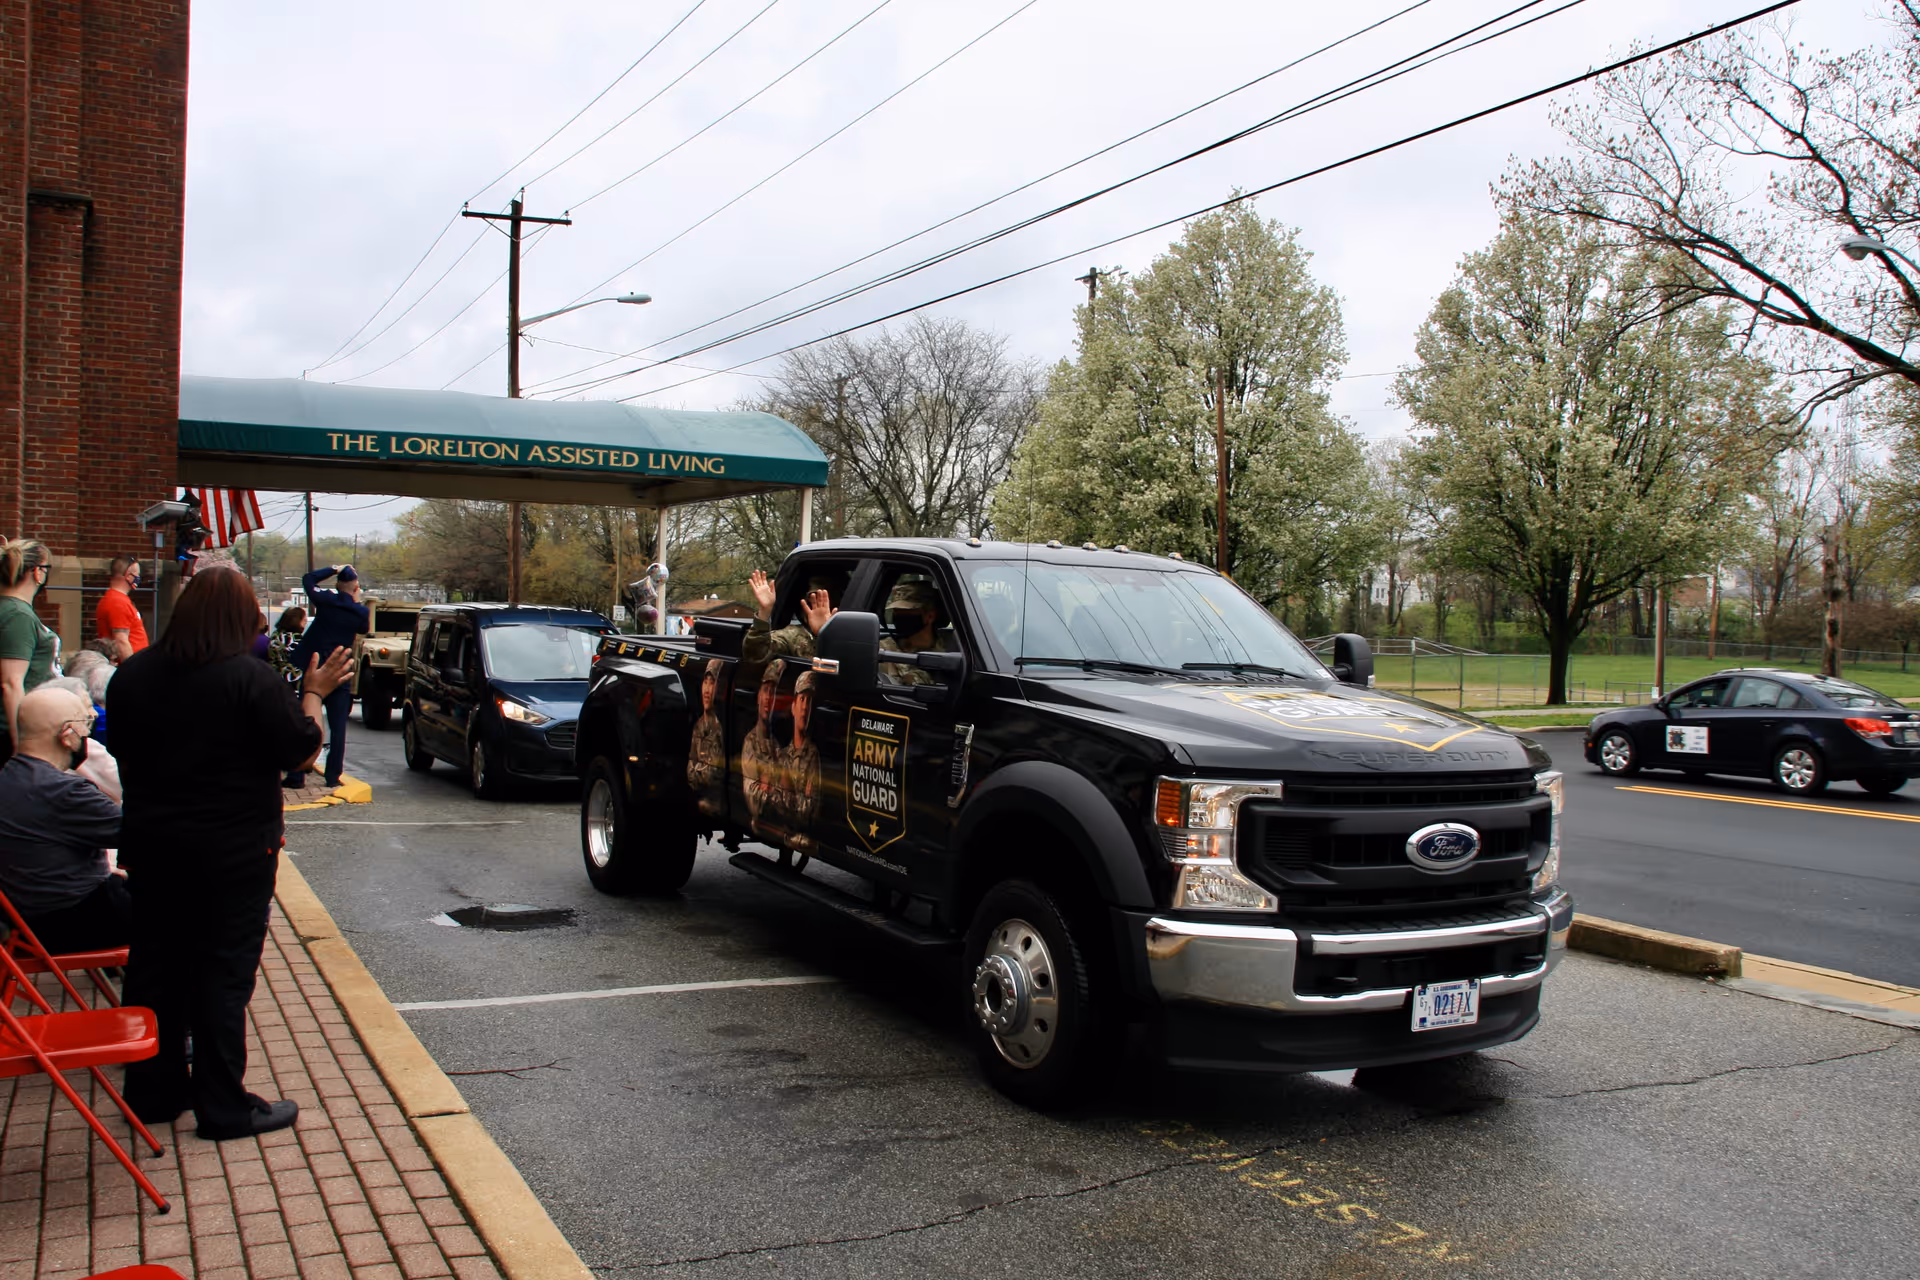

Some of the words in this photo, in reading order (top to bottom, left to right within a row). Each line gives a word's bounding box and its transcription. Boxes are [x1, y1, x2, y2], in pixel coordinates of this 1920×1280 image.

[327, 433, 379, 453] THE
[390, 436, 519, 461] LORELTON
[527, 445, 639, 468] ASSISTED
[648, 453, 725, 475] LIVING
[861, 718, 894, 735] DELAWARE
[853, 738, 898, 769] ARMY
[1338, 750, 1444, 764] SUPER
[1447, 750, 1510, 762] DUTY
[852, 763, 897, 787] NATIONAL
[852, 780, 898, 812] GUARD
[1429, 835, 1465, 857] Ford
[1434, 991, 1472, 1016] 0217X
